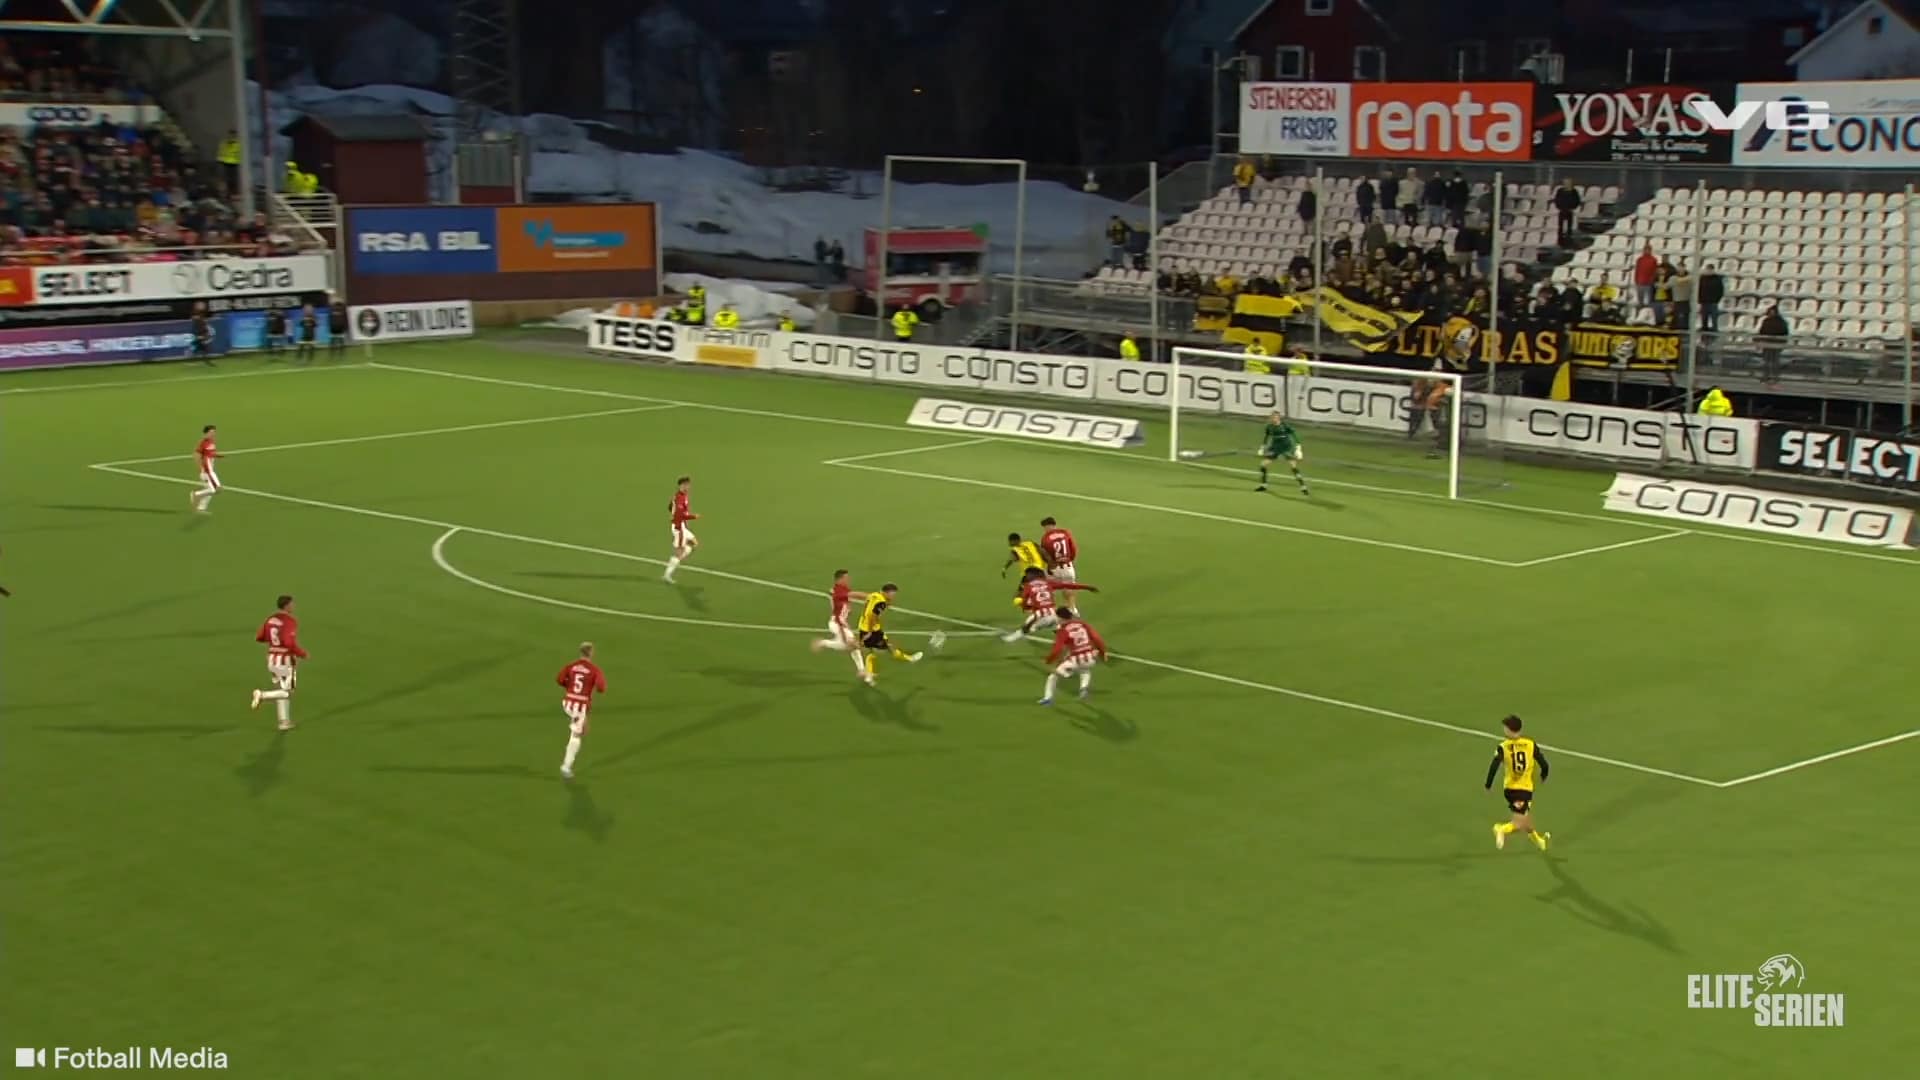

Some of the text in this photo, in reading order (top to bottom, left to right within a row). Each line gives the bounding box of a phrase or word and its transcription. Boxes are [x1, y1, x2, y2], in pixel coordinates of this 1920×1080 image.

[1249, 87, 1336, 111] STENERSEN
[1356, 90, 1523, 153] renta
[1554, 92, 1711, 138] YONAS
[1281, 116, 1337, 141] FRISØR
[359, 231, 492, 252] RSA BIL
[39, 269, 132, 298] SELECT
[208, 263, 293, 291] Cedra
[594, 319, 675, 352] TESS
[1053, 539, 1067, 559] 21
[573, 673, 584, 694] 5
[1511, 751, 1527, 775] 19
